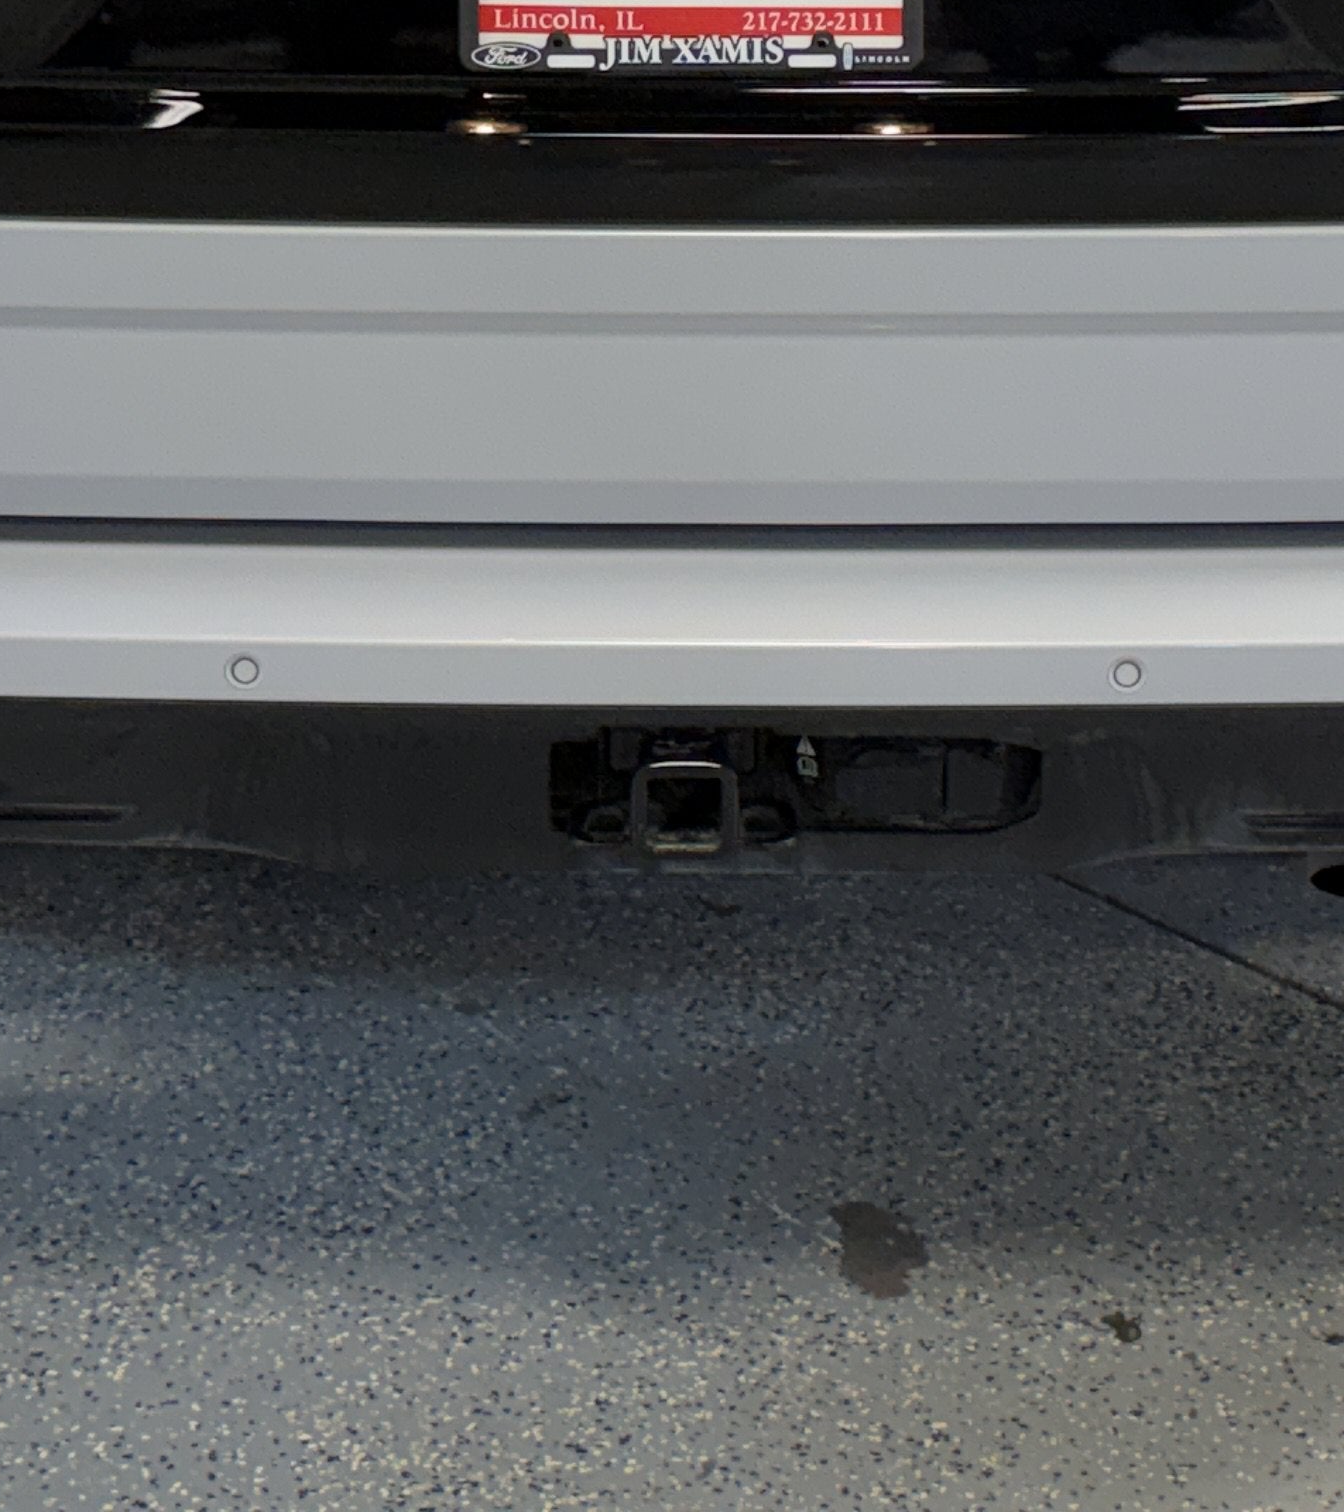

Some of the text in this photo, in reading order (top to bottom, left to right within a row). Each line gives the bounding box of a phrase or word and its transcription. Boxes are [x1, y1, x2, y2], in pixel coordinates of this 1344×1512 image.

[494, 8, 644, 32] Lincoln, IL
[742, 11, 884, 33] 217-732-2111
[483, 46, 527, 66] Ford
[599, 36, 784, 71] JIM XAMIS
